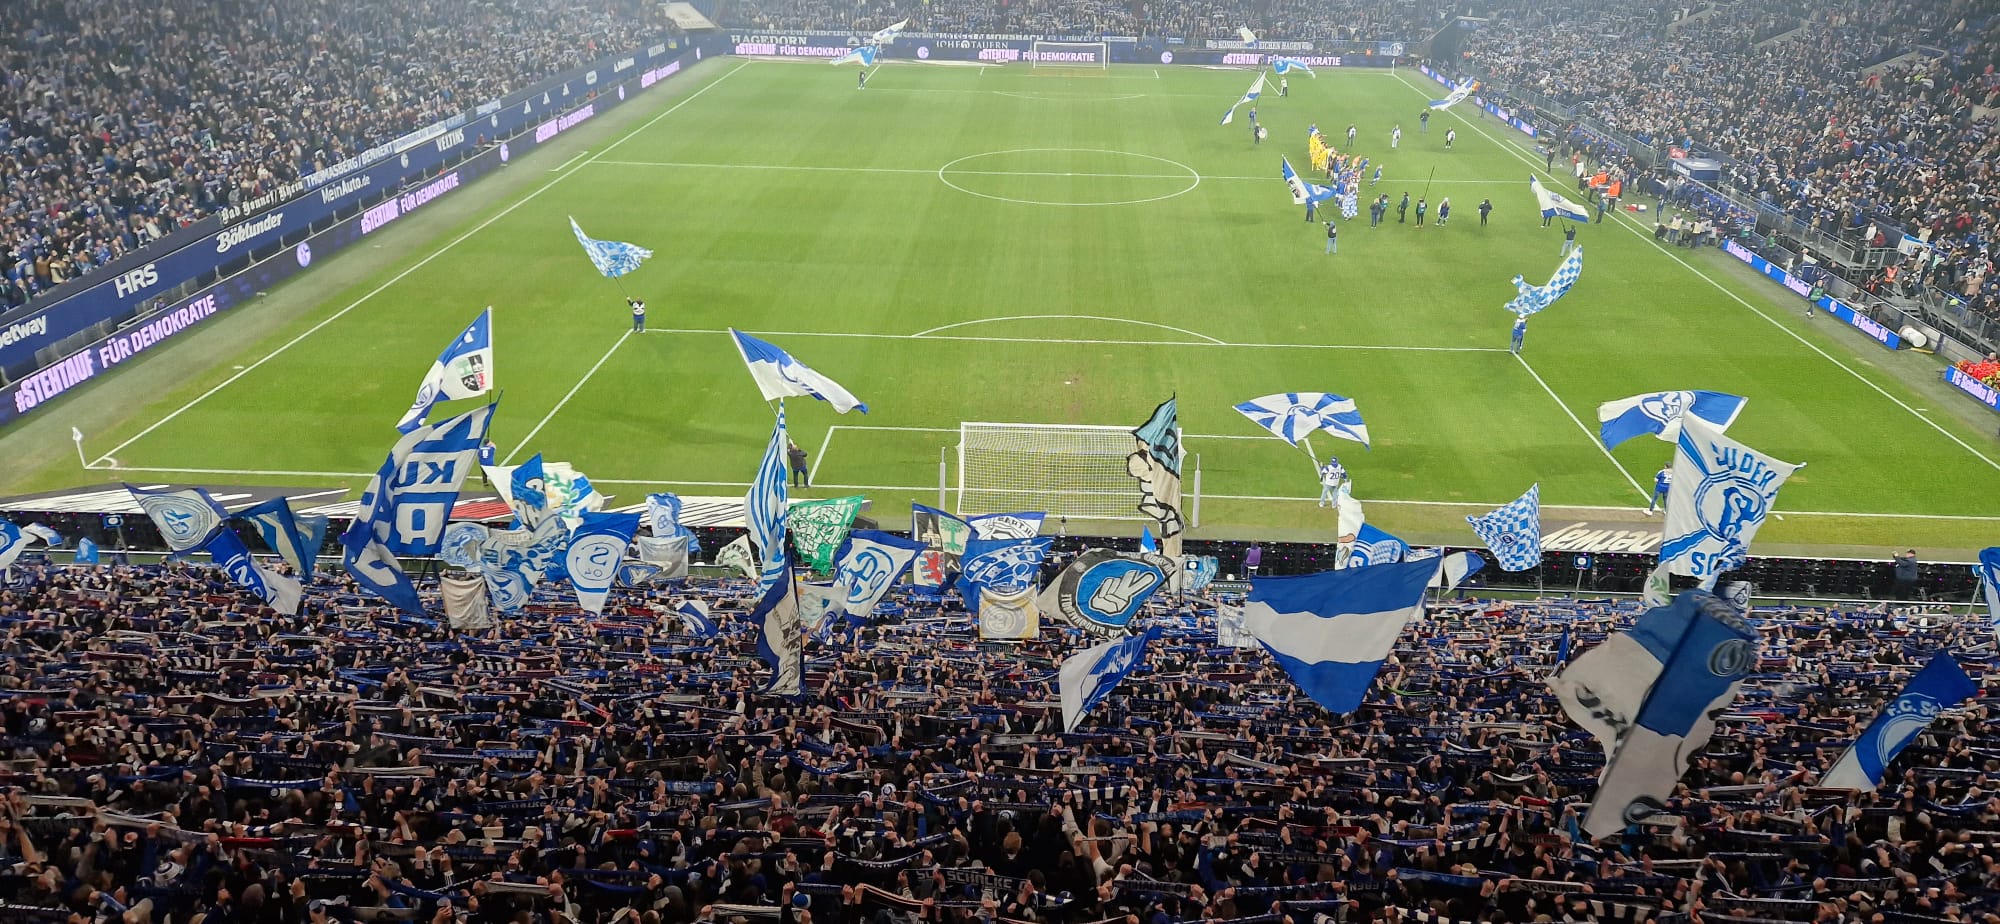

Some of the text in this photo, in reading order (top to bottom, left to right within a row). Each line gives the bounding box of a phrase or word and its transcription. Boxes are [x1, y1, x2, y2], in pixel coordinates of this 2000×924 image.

[731, 35, 807, 45] HAGEDORN
[780, 45, 796, 56] FÜR
[1041, 52, 1095, 62] DEMOKRATIE
[436, 128, 465, 152] VELTINS
[306, 159, 358, 187] THOMASBERG
[321, 174, 371, 204] MeinAuto.de
[400, 192, 417, 213] FÜR
[416, 172, 460, 206] DEMOKRATIE
[216, 213, 283, 253] Böklunder
[115, 264, 158, 298] HRS
[15, 294, 217, 413] #STEHTAUF FÜR DEMOKRATIE
[1952, 370, 1997, 406] FC Schalke 04
[947, 870, 1013, 889] SCHALKE
